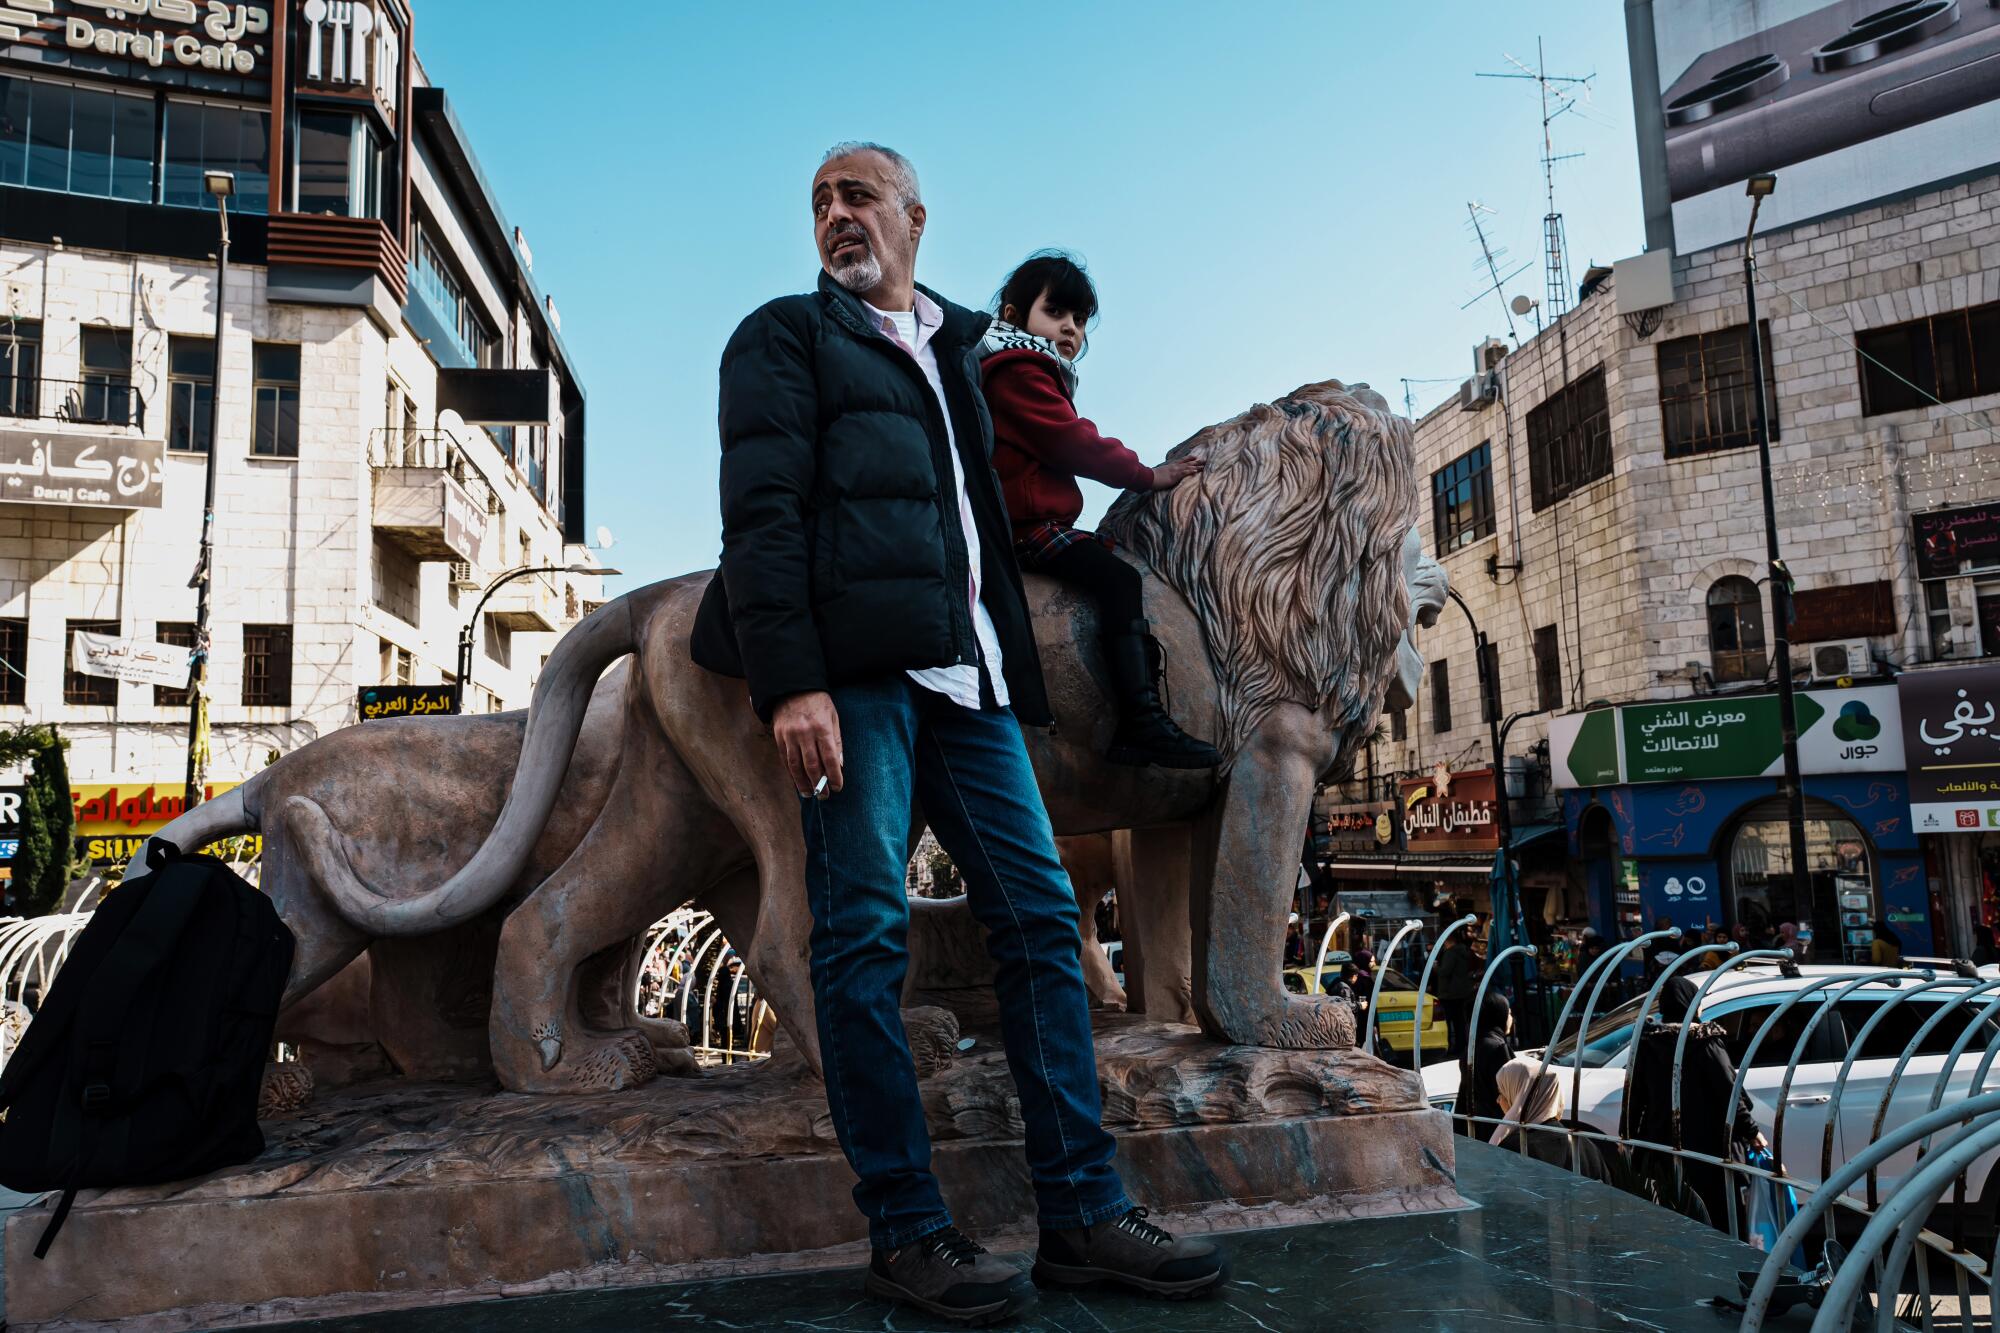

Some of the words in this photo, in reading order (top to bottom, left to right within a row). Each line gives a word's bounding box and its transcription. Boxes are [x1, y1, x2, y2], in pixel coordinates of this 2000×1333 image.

[65, 16, 165, 67] Daraj
[33, 485, 74, 503] Daraj
[76, 488, 111, 503] Cafe
[364, 695, 408, 718] العربي
[409, 692, 451, 715] المركز
[1640, 710, 1690, 737] الشني
[1694, 710, 1747, 728] معرض
[1642, 733, 1720, 753] للاتصالات
[1839, 744, 1879, 760] جوال
[1403, 802, 1440, 840] النبالي
[1443, 799, 1491, 834] قطيفان
